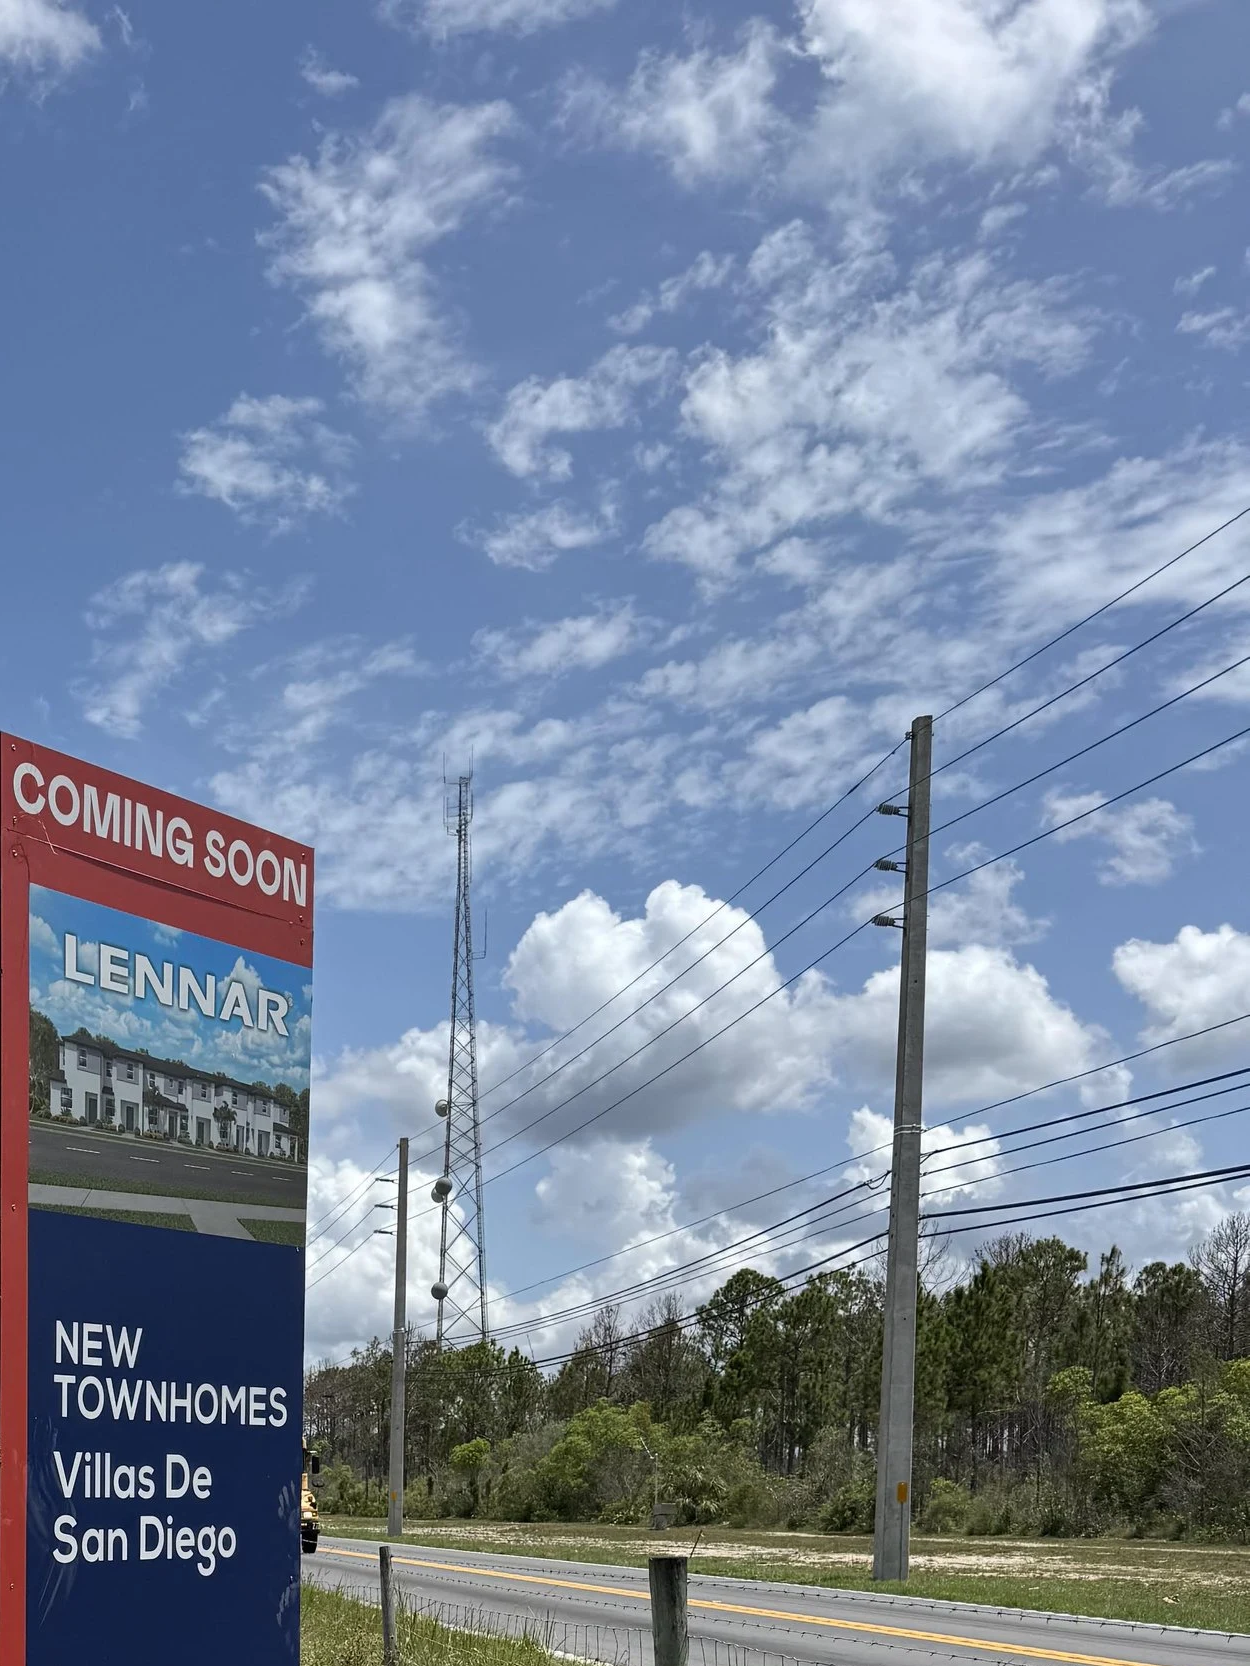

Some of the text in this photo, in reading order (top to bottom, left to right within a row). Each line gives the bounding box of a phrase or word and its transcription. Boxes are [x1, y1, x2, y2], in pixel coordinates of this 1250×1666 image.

[13, 762, 307, 907] COMING SOON
[55, 1320, 143, 1368] NEW
[53, 1375, 288, 1428] TOWNHOMES
[53, 1451, 212, 1499] Villas De
[52, 1514, 237, 1577] San Diego
